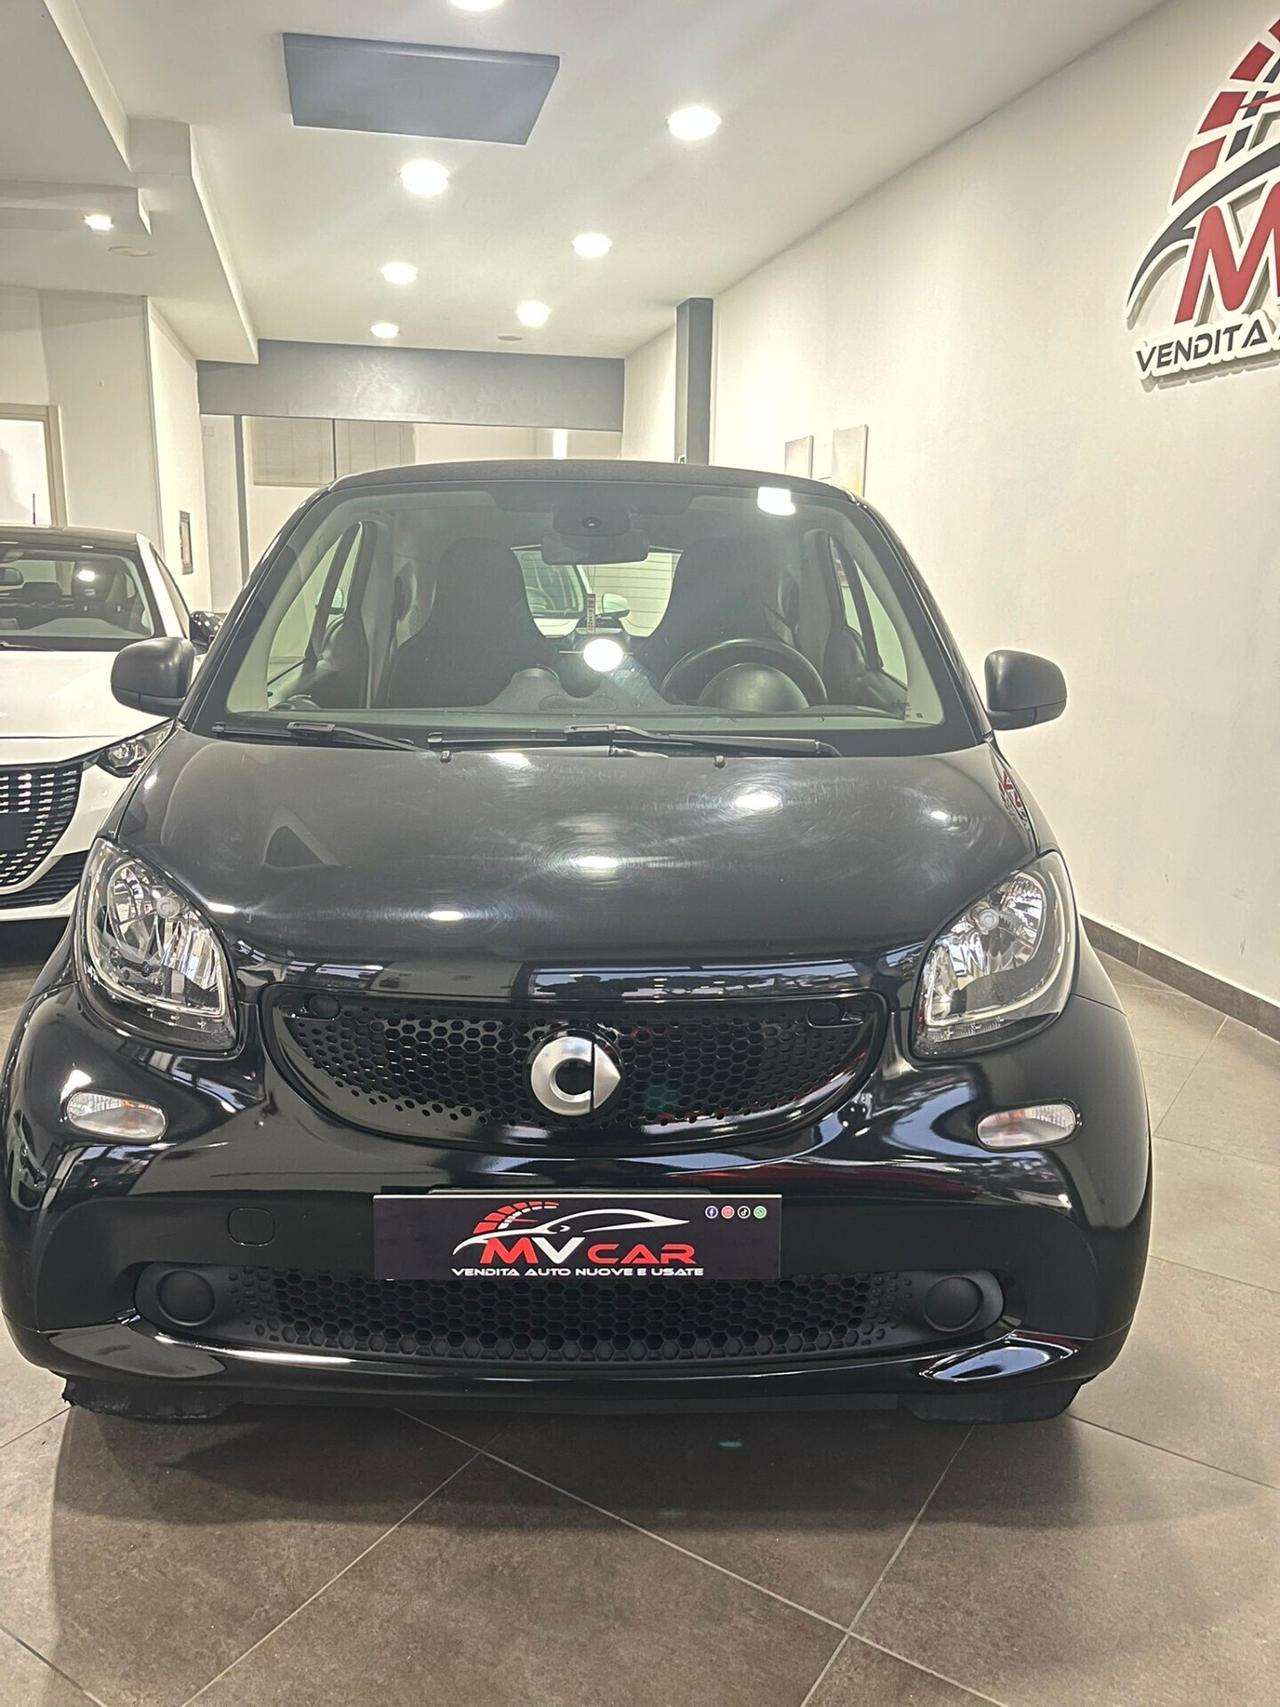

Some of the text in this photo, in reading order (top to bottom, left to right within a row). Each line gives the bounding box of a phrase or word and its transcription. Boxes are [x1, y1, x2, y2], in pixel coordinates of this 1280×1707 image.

[1136, 319, 1268, 372] VENDITA
[451, 1268, 704, 1276] VENDITA AUTO NUOVE E USATE
